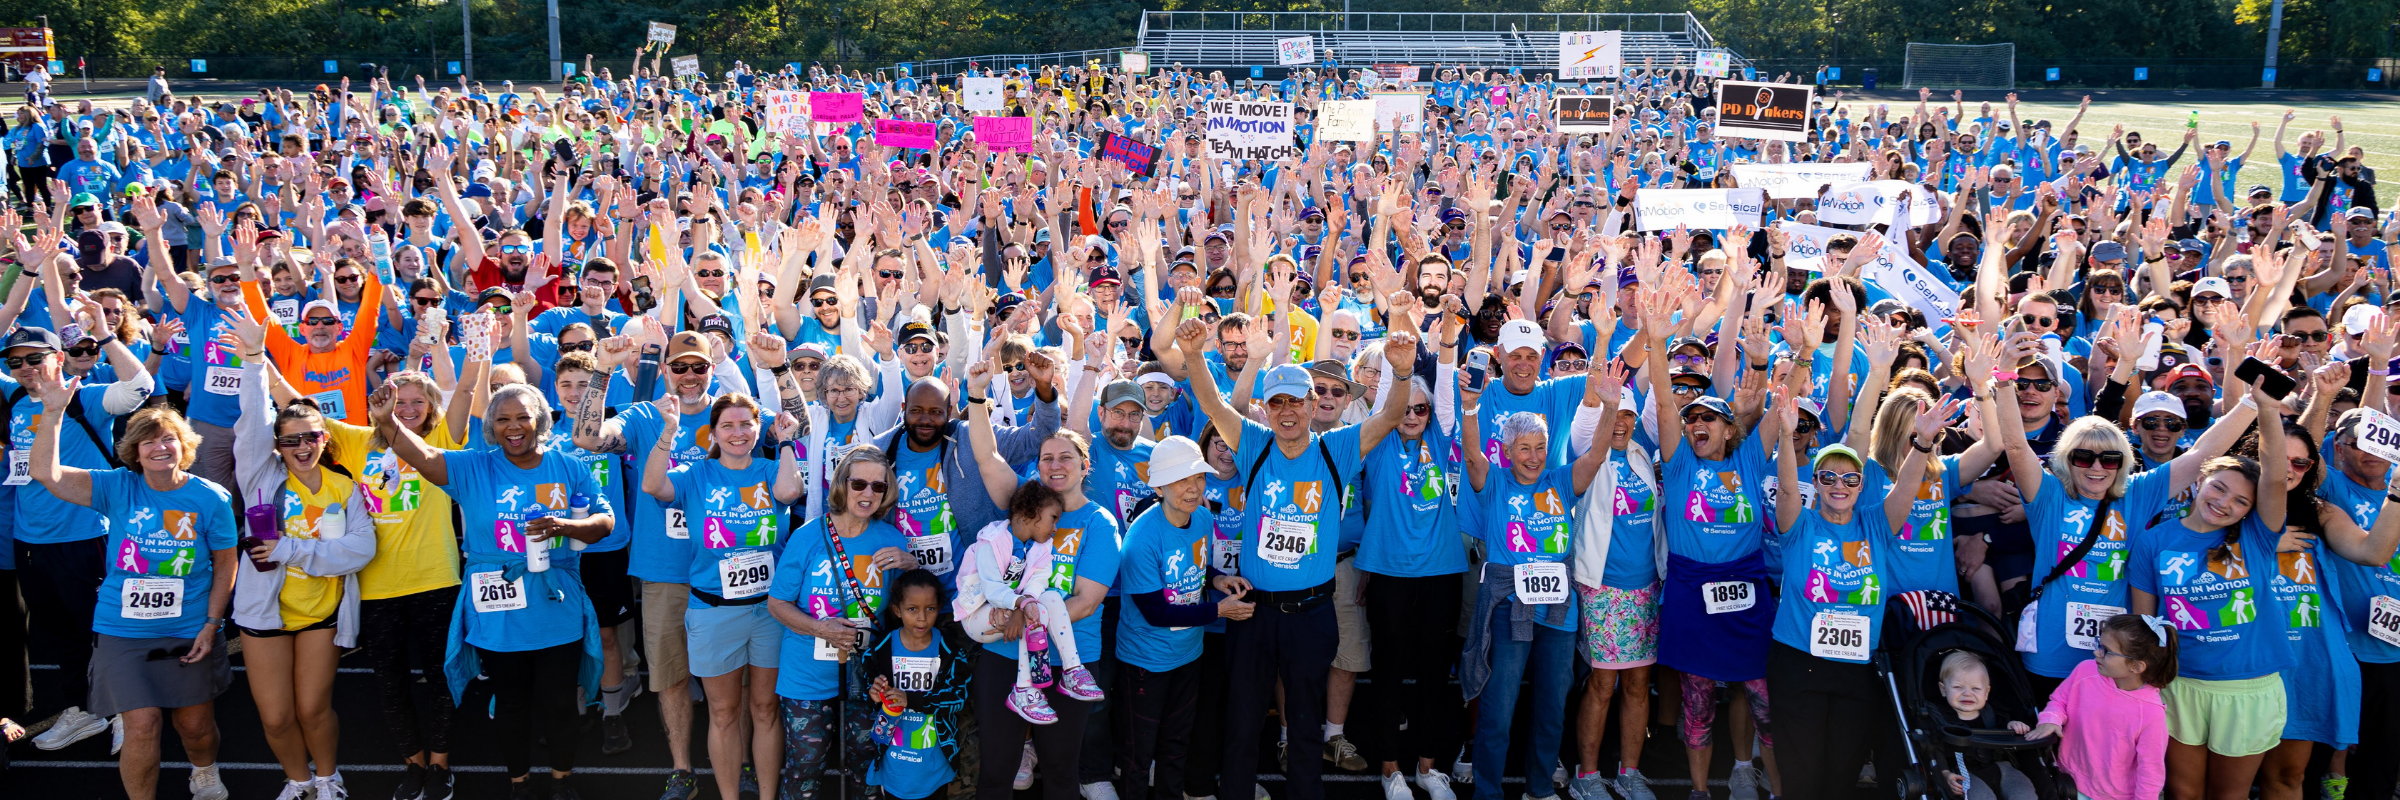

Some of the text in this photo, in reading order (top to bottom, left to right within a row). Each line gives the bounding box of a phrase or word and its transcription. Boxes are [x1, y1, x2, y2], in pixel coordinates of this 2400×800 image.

[1568, 34, 1592, 46] JUDY'S
[1566, 66, 1614, 76] JUGGERNAUTS
[1211, 102, 1287, 117] WE MOVE!
[1722, 103, 1742, 114] PD
[978, 118, 1028, 133] PALS IN
[1207, 116, 1285, 134] IN MOTION
[984, 132, 1024, 143] MOTION
[1113, 135, 1150, 159] TEAM
[1209, 139, 1292, 160] TEAM HATCH
[1814, 172, 1870, 182] Sensical
[1889, 197, 1936, 206] Ssical
[1637, 202, 1760, 217] InMotion Sensical
[1791, 241, 1821, 256] otion
[1100, 267, 1108, 276] C
[1915, 280, 1955, 318] Sensic
[273, 307, 294, 318] 1552
[211, 375, 240, 388] 2921
[321, 400, 337, 414] 91
[400, 473, 418, 481] TION
[923, 494, 947, 505] MOTIO
[1923, 501, 1944, 511] MOTION
[498, 510, 566, 520] PALS TION
[673, 512, 688, 528] 23
[740, 508, 773, 519] MOTION
[1229, 513, 1245, 521] MOT
[1287, 514, 1318, 522] MOTION
[1537, 516, 1565, 525] MOTION
[1265, 532, 1306, 553] 2346
[2062, 533, 2126, 550] PALS MOTION
[1053, 554, 1073, 562] TION
[1223, 552, 1240, 568] 21
[287, 571, 307, 580] ensical
[728, 564, 769, 587] 2299
[1812, 563, 1832, 575] PALS
[1843, 565, 1873, 580] MOTION
[812, 587, 833, 595] PALS
[1523, 576, 1561, 593] 1892
[2164, 579, 2250, 595] PALS IN MOTION
[2280, 584, 2317, 593] MOTION
[480, 582, 517, 602] 2615
[1710, 583, 1748, 602] 1893
[2190, 593, 2228, 602] 09.14.2025
[130, 591, 175, 609] 2493
[2372, 606, 2400, 633] 248
[1818, 627, 1862, 648] 2305
[2206, 633, 2240, 643] Sensical
[894, 671, 932, 690] 1588
[898, 753, 922, 763] Sensical
